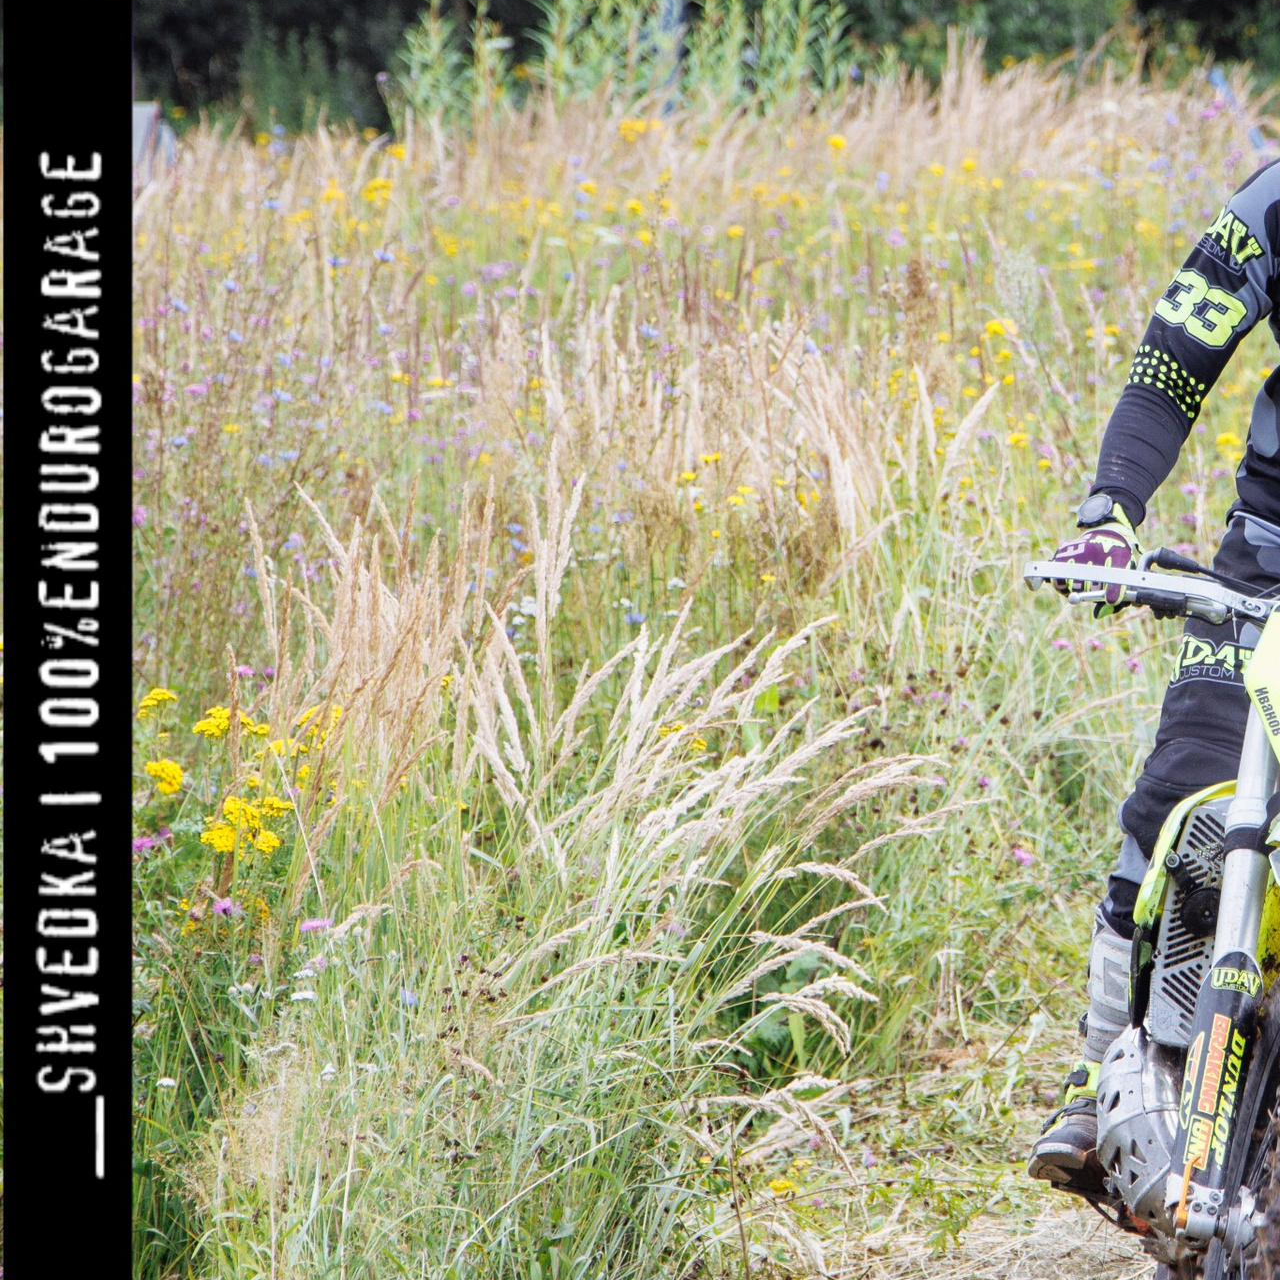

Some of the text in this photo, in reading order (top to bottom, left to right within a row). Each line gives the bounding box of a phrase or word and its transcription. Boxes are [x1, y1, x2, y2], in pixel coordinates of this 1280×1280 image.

[1154, 270, 1248, 348] 33
[1180, 665, 1235, 680] CUSTOM
[1212, 968, 1261, 997] UDAV
[1198, 1013, 1232, 1115] BRAKING
[1211, 1028, 1246, 1166] DUNLOP
